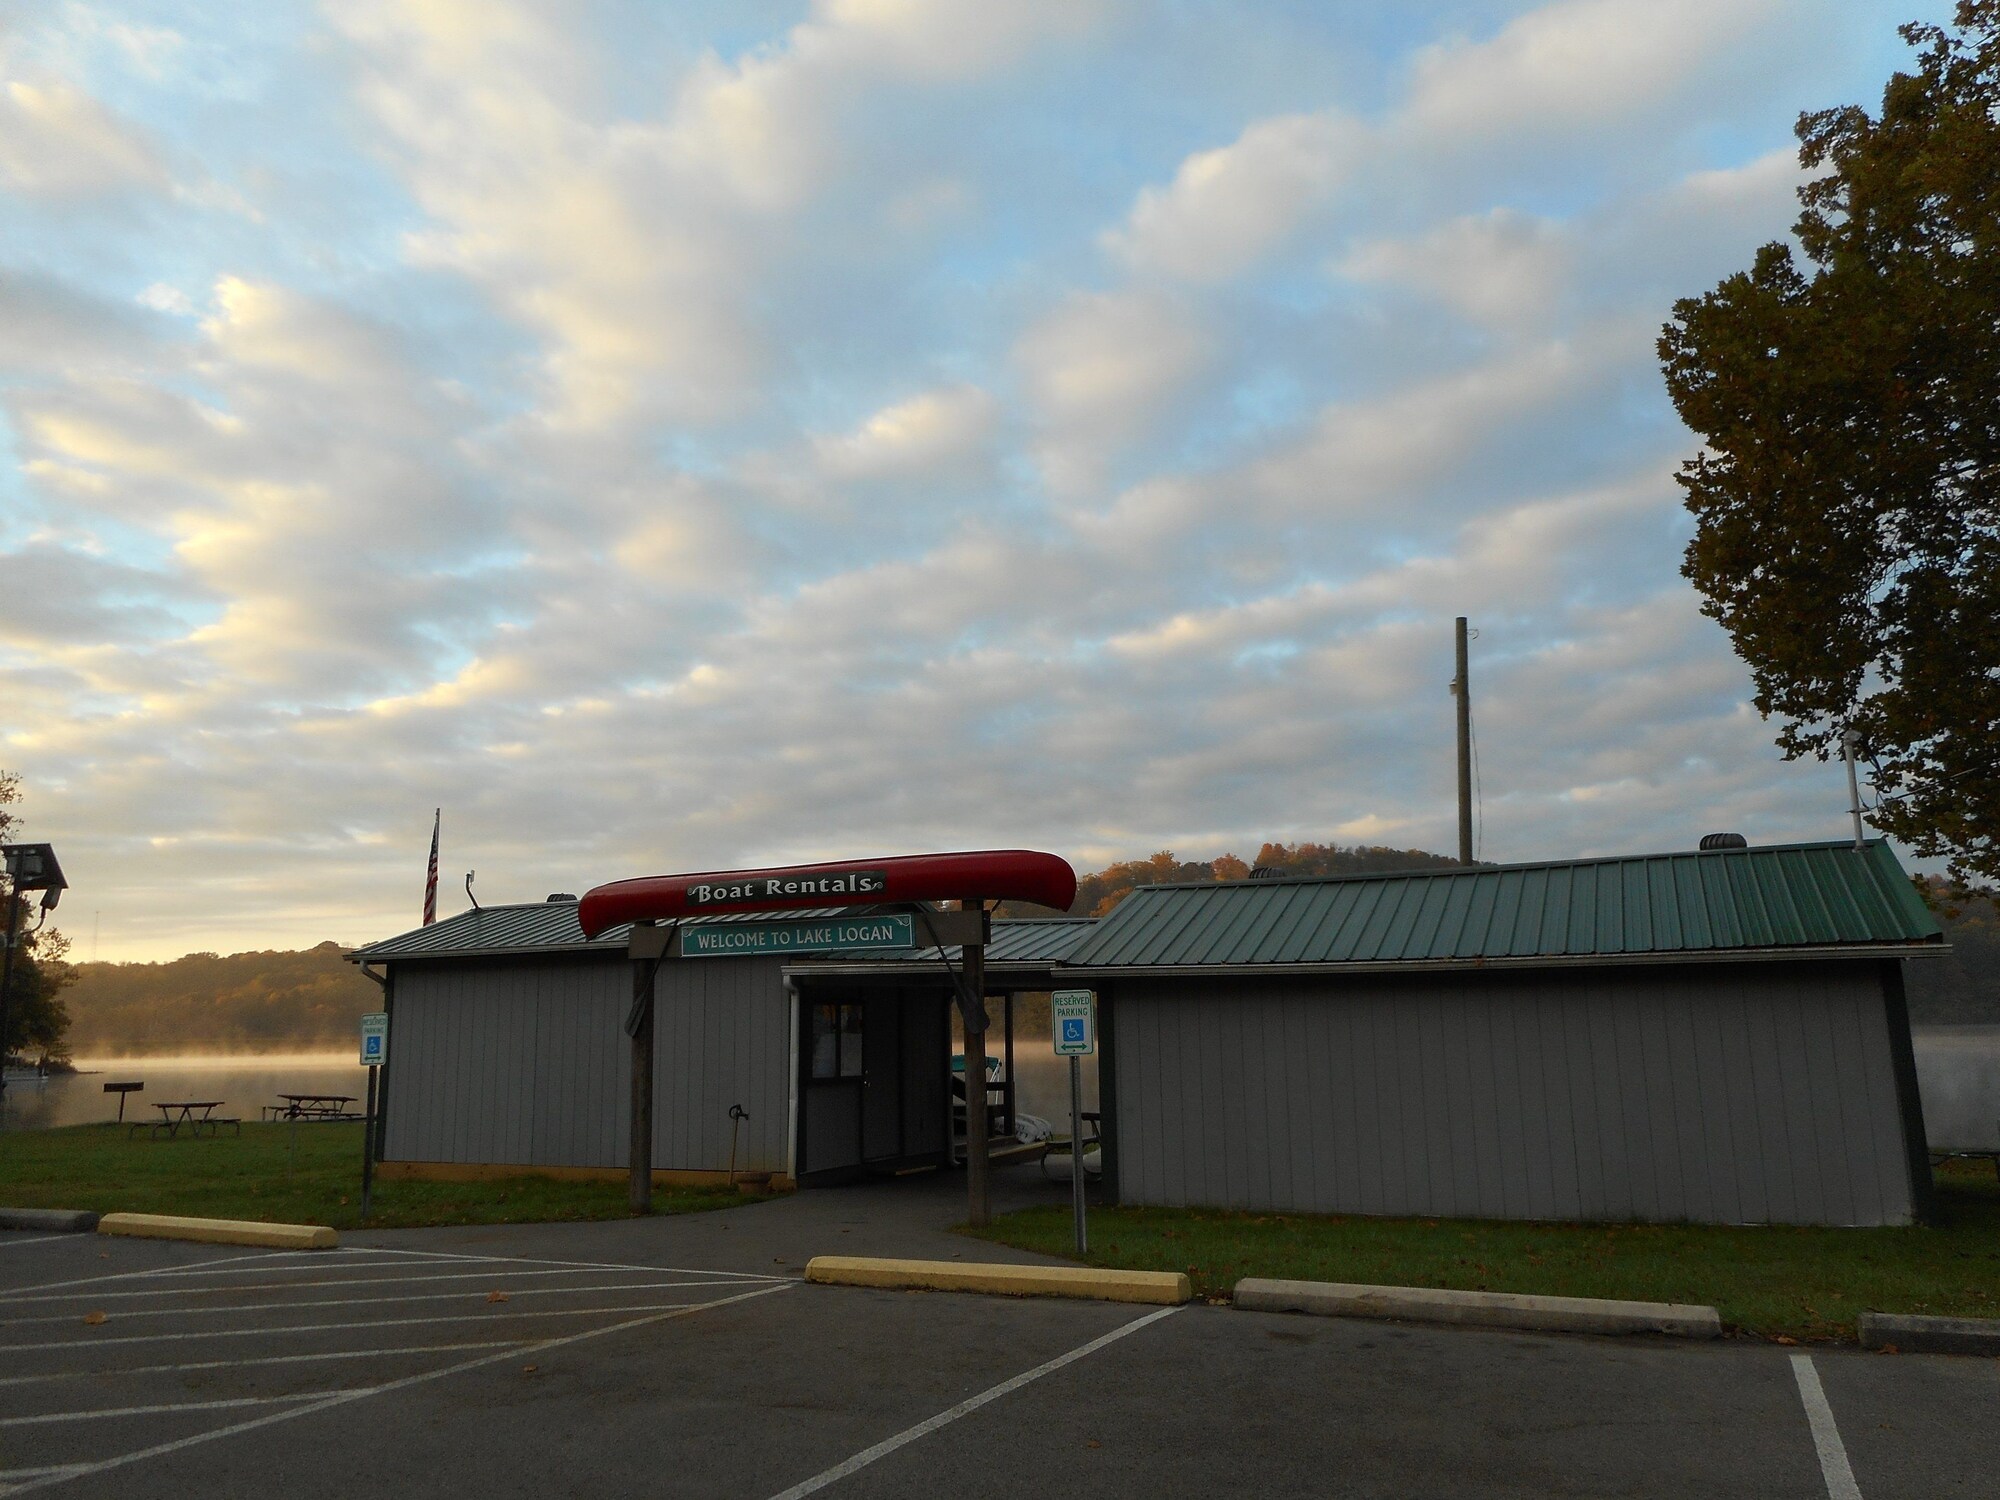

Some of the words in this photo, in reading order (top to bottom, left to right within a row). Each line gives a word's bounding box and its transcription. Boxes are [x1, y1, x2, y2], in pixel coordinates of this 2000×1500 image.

[689, 883, 753, 902] Boat
[766, 874, 882, 895] Rentals
[698, 932, 766, 949] WELCOME
[771, 931, 790, 945] TO
[796, 928, 832, 944] LAKE
[838, 925, 893, 942] LOGAN
[1055, 996, 1090, 1006] RESERVED
[1057, 1007, 1088, 1017] PARKING
